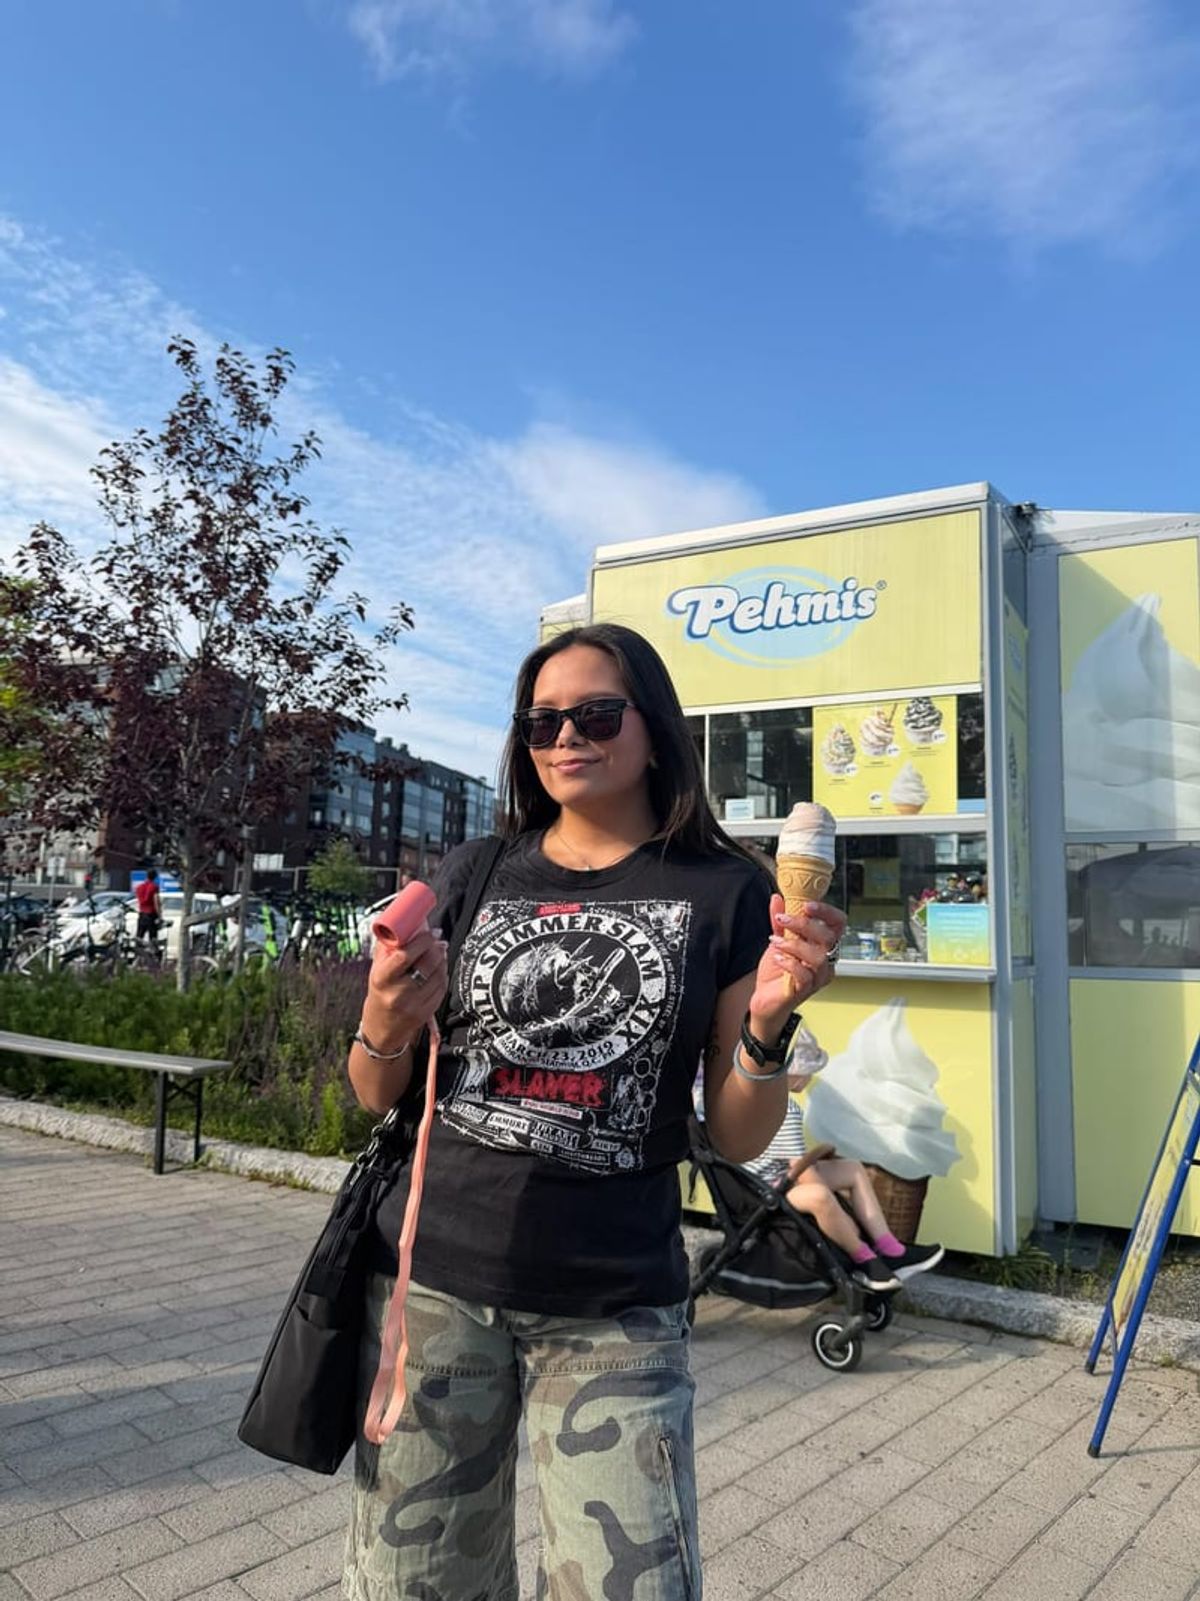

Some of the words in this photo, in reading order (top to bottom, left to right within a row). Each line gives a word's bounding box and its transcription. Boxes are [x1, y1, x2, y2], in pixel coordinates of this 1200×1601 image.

[479, 914, 604, 970] SUMMER
[606, 921, 663, 981] SLAM
[614, 994, 661, 1047] XIX
[577, 1041, 614, 1061] 2019
